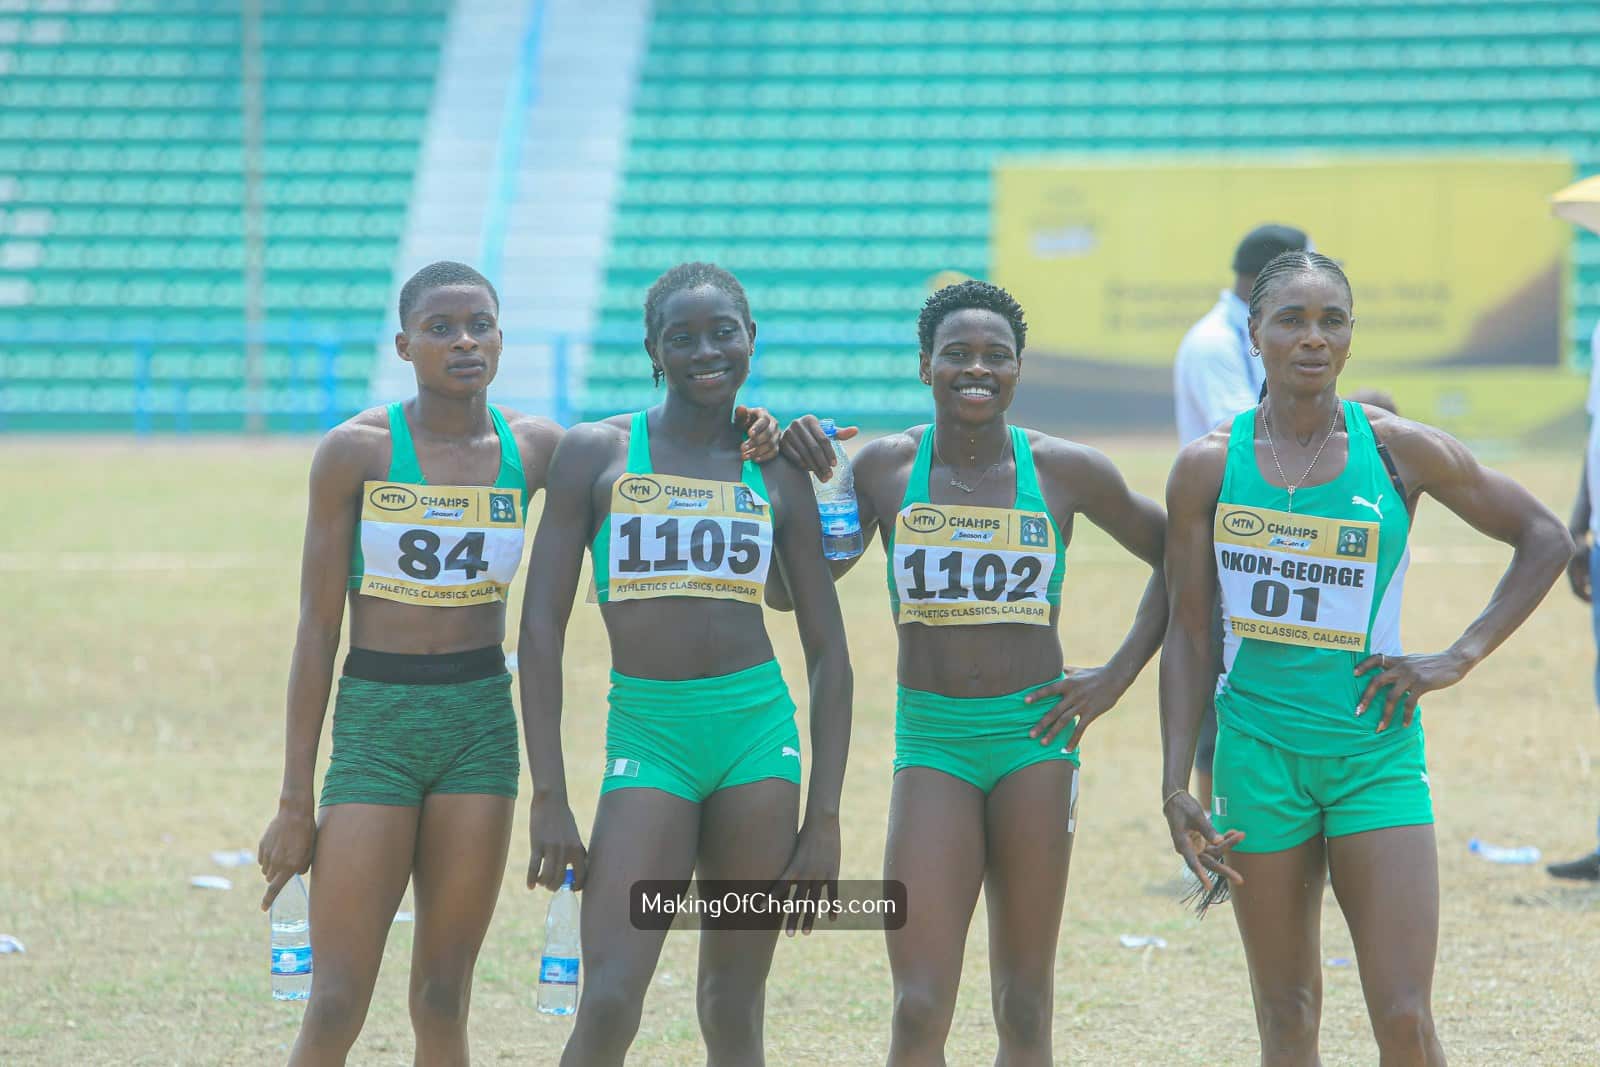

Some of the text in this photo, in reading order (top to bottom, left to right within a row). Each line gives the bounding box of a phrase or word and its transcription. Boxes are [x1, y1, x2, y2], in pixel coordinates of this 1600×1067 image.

[380, 493, 406, 504] MTN
[664, 485, 714, 499] CHAMPS
[420, 496, 470, 508] CHAMPS
[912, 515, 936, 526] MTN
[948, 516, 1001, 530] CHAMPS
[1231, 517, 1254, 530] MTN
[958, 531, 982, 540] Season
[1267, 522, 1318, 540] CHAMPS
[618, 516, 761, 575] 1105
[398, 528, 489, 581] 84
[903, 549, 1042, 603] 1102
[1221, 550, 1365, 589] OKON-GEORGE
[368, 581, 420, 598] ATHLETICS
[616, 581, 757, 597] ATHLETICS CLASSICS, CALABAR
[1250, 579, 1321, 623] 01
[906, 605, 1044, 620] ATHLETICS CLASSICS, CALABAR
[1258, 624, 1311, 641] CLASSICS,
[1312, 632, 1361, 647] CALABAR
